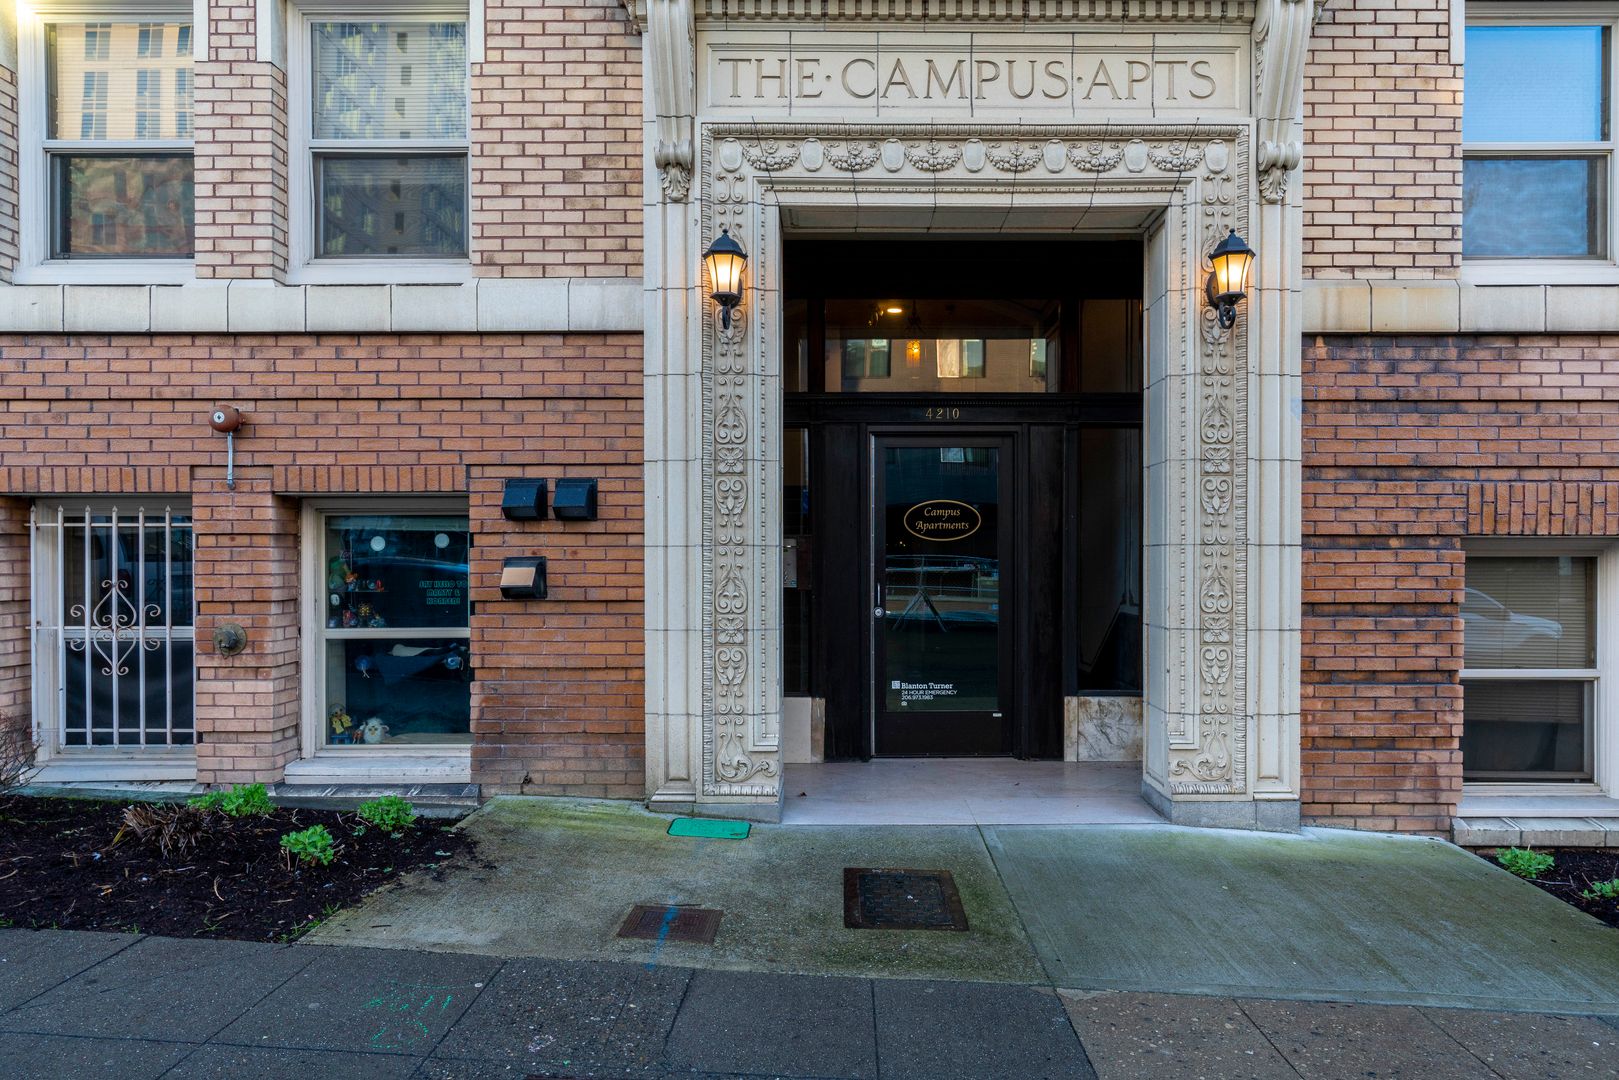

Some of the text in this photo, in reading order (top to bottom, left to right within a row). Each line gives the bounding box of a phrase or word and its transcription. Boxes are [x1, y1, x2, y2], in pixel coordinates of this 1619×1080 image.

[717, 57, 1217, 100] THE CAMPUS APTS
[925, 407, 961, 420] 4210
[924, 507, 961, 520] Campus
[915, 520, 969, 534] Apartments
[901, 682, 928, 690] Blanton
[928, 682, 954, 690] Turner
